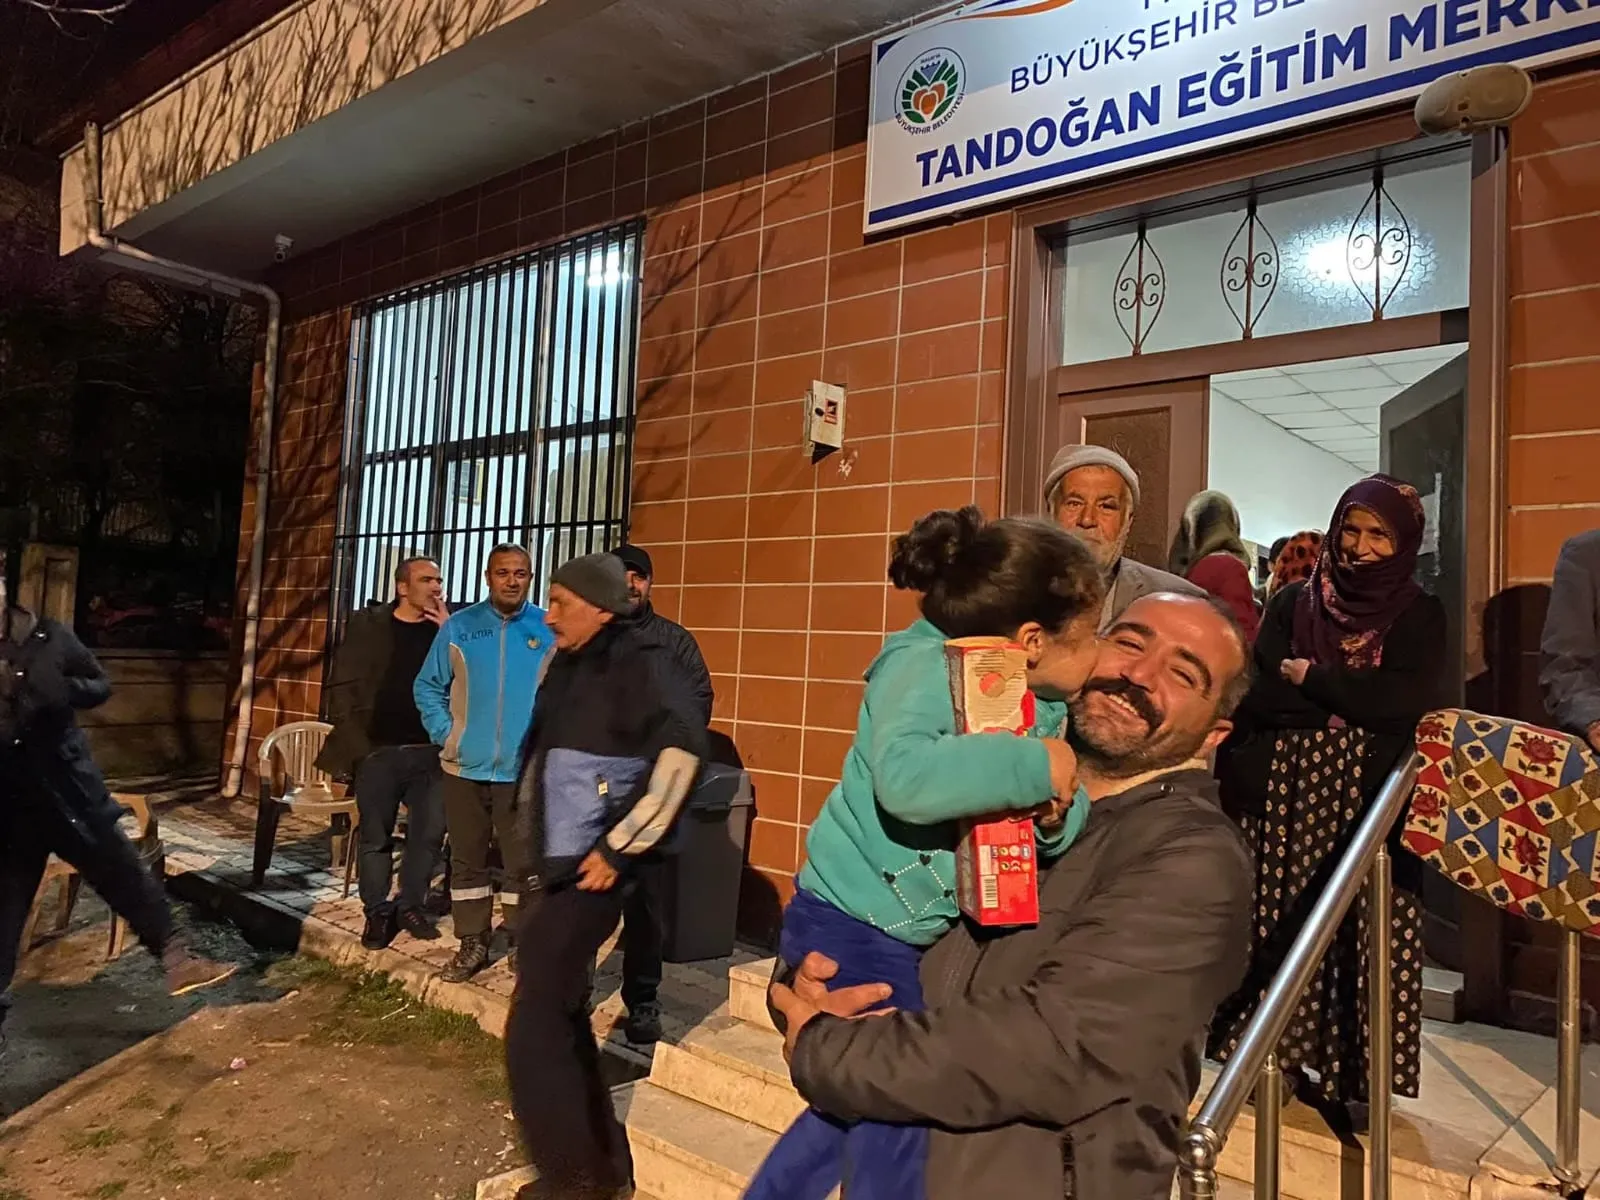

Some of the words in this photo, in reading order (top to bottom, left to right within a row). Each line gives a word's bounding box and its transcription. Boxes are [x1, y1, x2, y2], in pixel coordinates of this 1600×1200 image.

[916, 85, 1161, 187] TANDOĞAN
[1179, 25, 1367, 118] EĞİTİM
[1011, 0, 1237, 93] BÜYÜKŞEHİR
